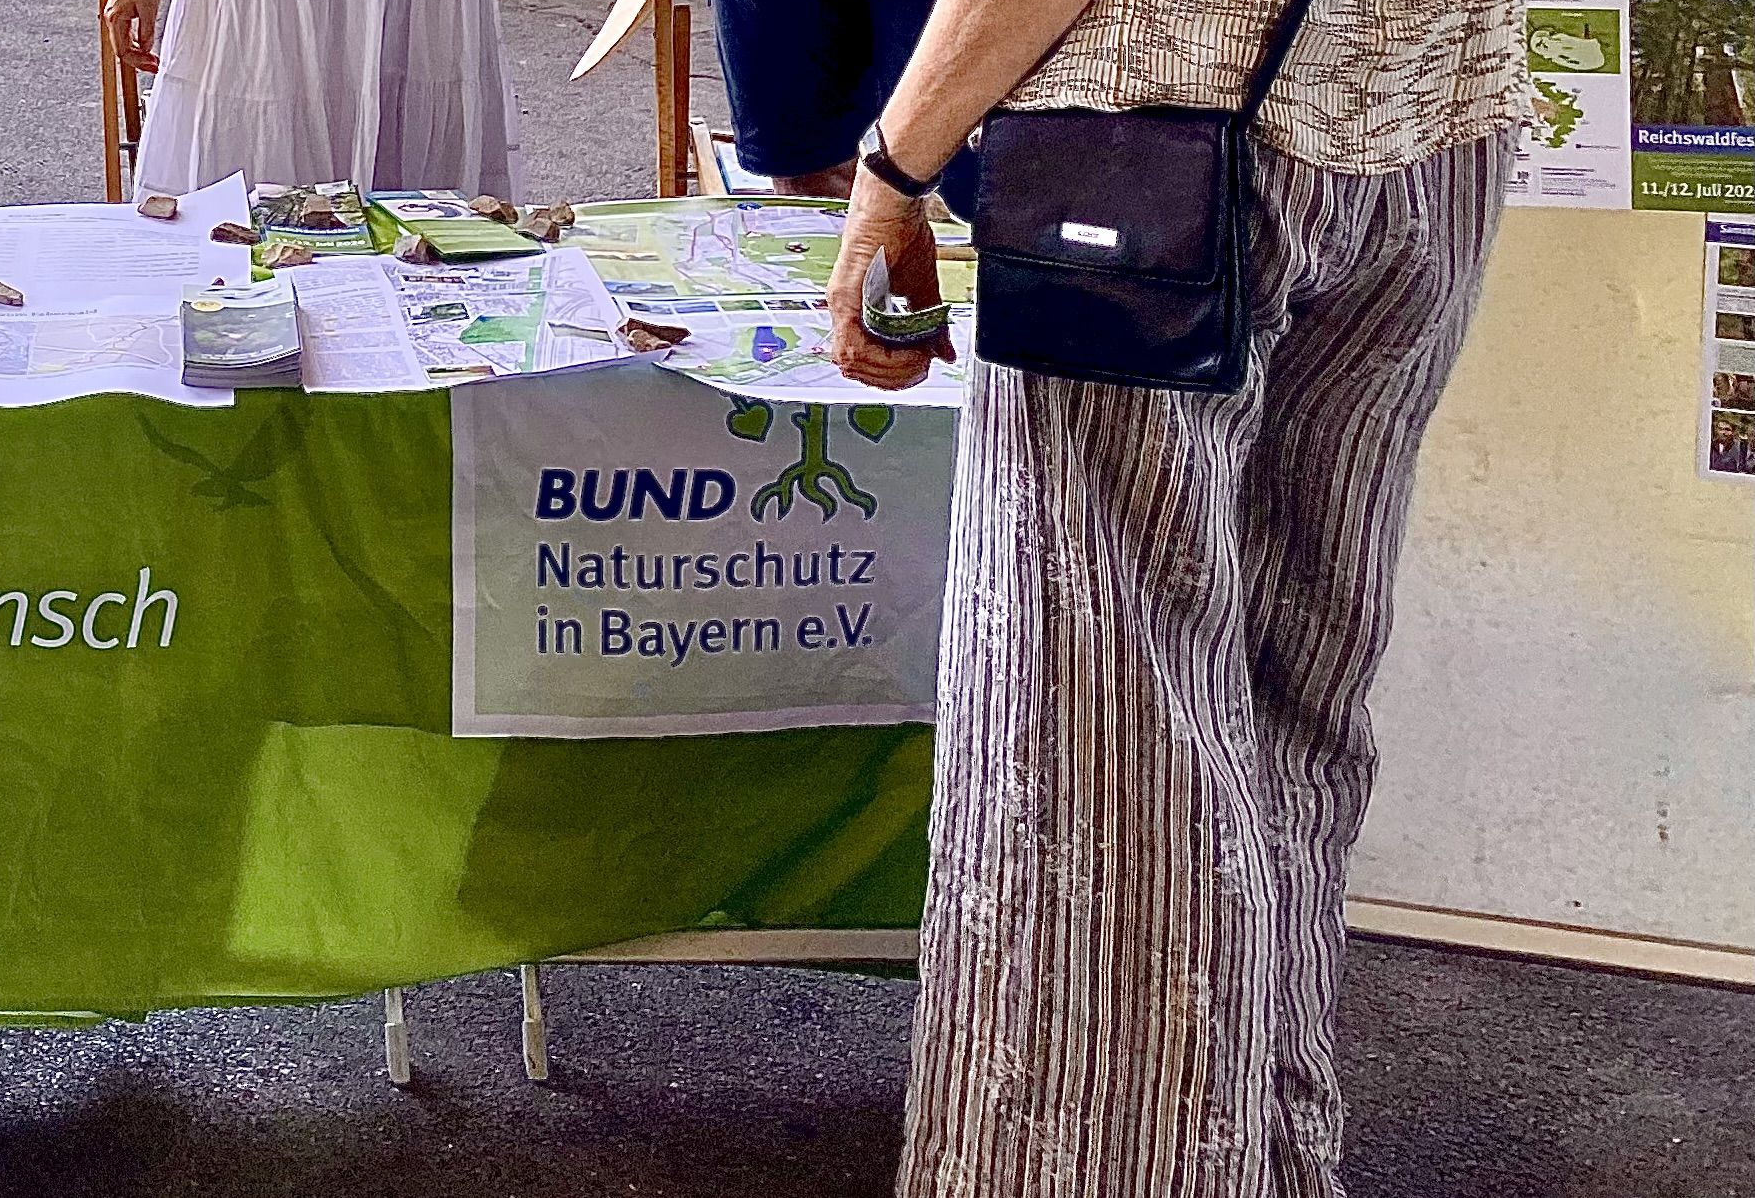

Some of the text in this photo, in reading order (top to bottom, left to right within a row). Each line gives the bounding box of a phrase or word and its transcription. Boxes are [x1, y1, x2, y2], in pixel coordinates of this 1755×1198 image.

[533, 467, 737, 522] BUND
[536, 539, 877, 590] Naturschutz
[536, 602, 875, 668] in Bayern e.V.
